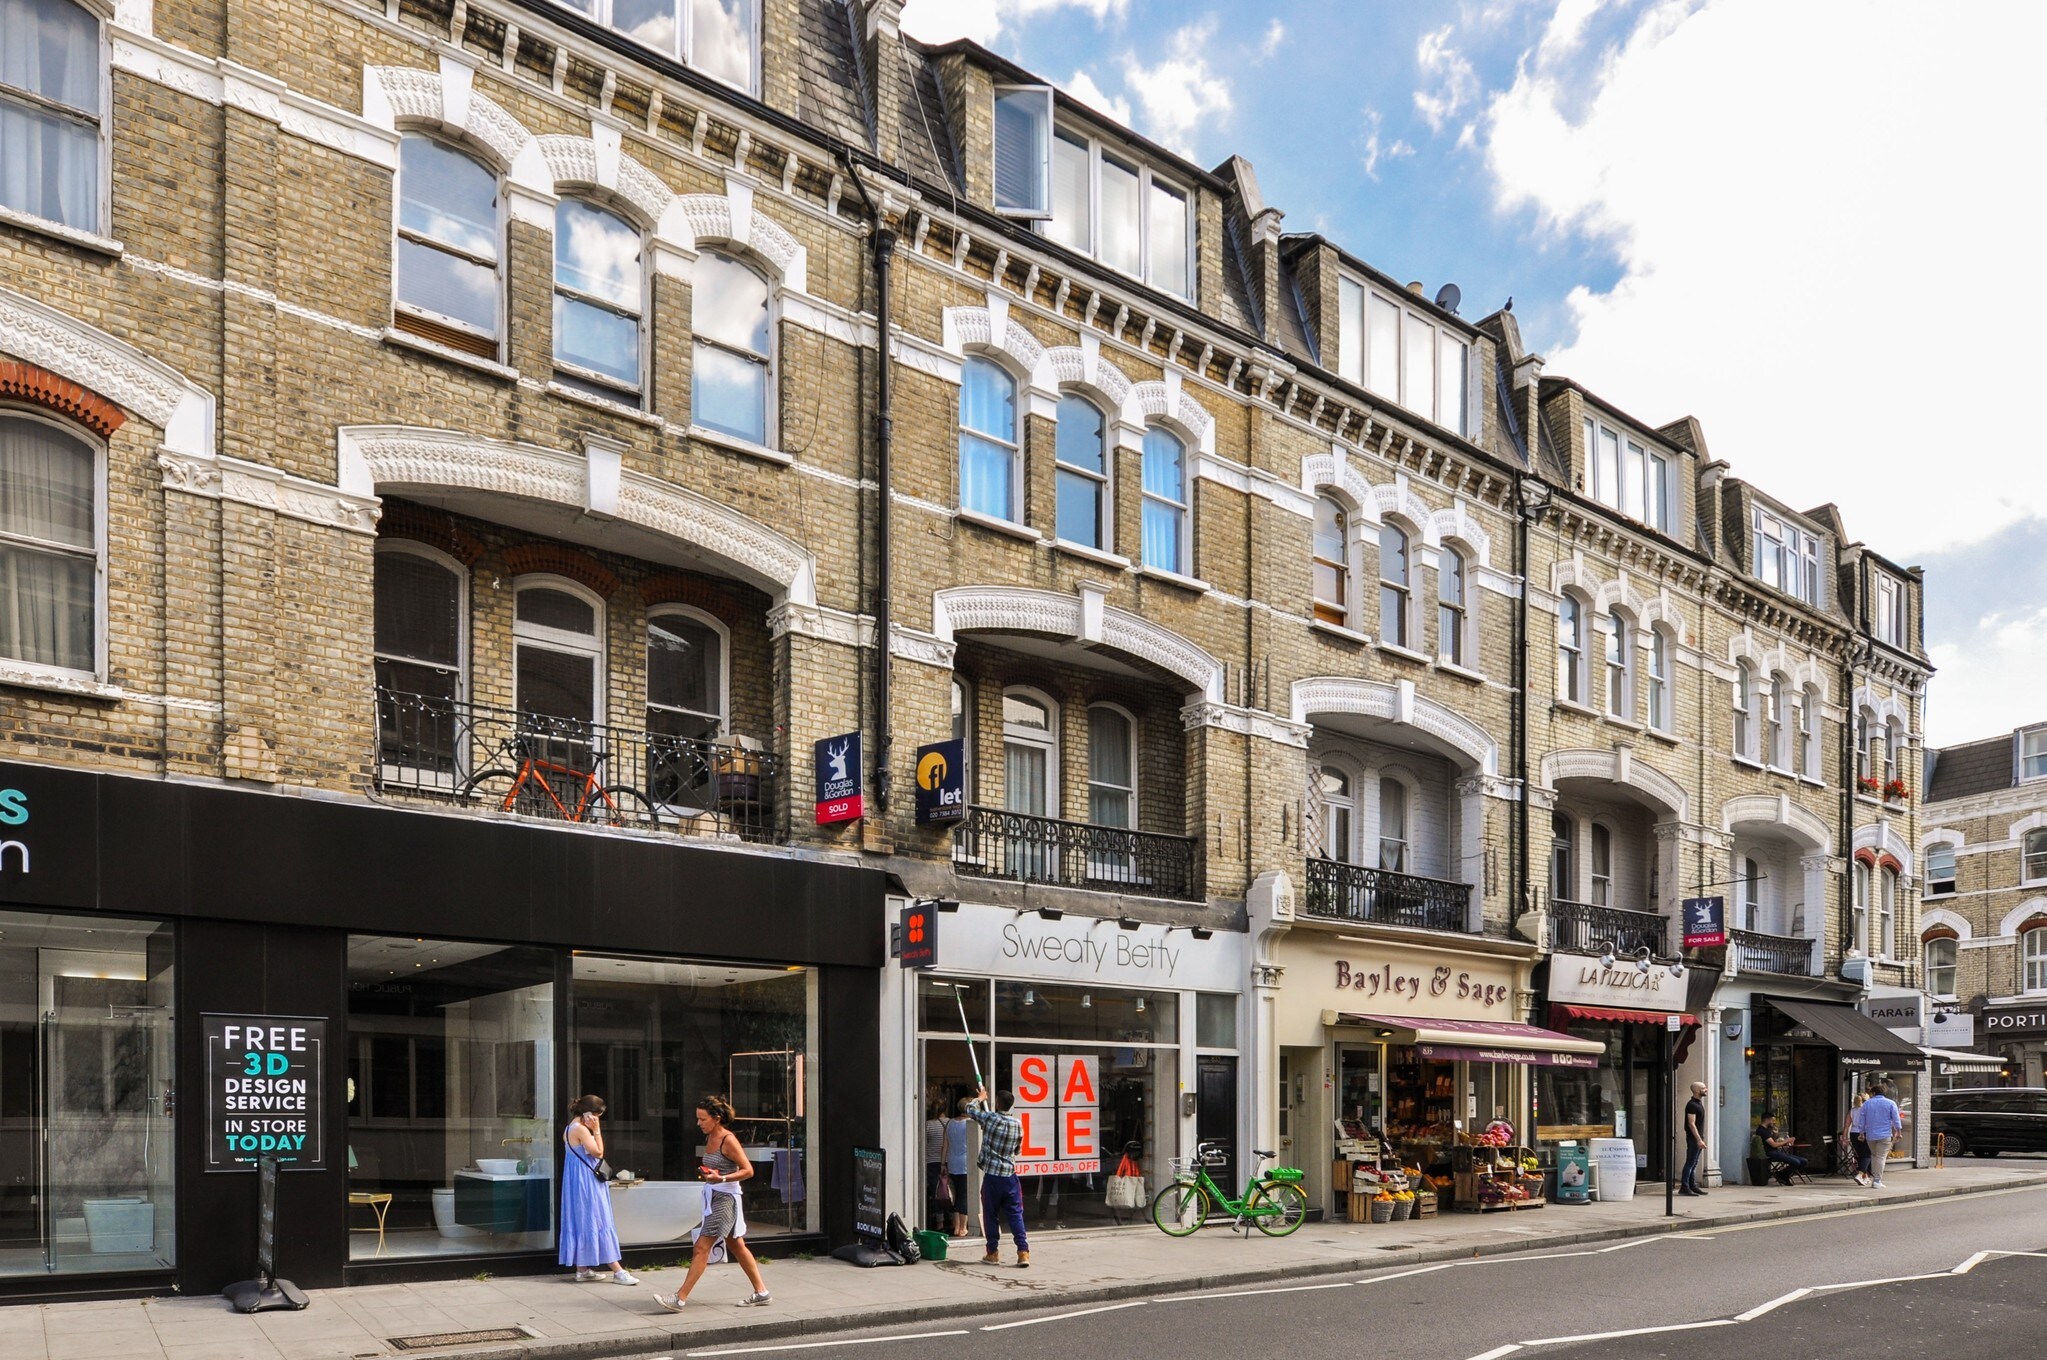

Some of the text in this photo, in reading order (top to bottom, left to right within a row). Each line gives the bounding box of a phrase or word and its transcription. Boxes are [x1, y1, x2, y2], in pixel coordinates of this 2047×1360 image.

[824, 779, 854, 792] Douglas
[824, 788, 854, 800] &Gordon
[940, 787, 962, 805] let
[828, 803, 849, 814] SOLD
[1691, 922, 1718, 931] Douglas
[1003, 923, 1180, 978] Sweaty Betty
[1335, 960, 1507, 1006] Bayley & Sage
[1579, 967, 1650, 990] LA PIZZICA
[1871, 1008, 1903, 1018] FARA
[1988, 1014, 2046, 1029] PORTI
[224, 1025, 307, 1051] FREE
[1422, 1047, 1433, 1055] 835
[244, 1052, 289, 1076] 3D
[225, 1078, 306, 1094] DESIGN
[225, 1096, 306, 1110] SERVICE
[225, 1120, 307, 1133] IN STORE
[226, 1135, 306, 1151] TODAY
[1015, 1161, 1099, 1175] UP TO 50% OFF
[857, 1222, 882, 1235] BOOK NOW
